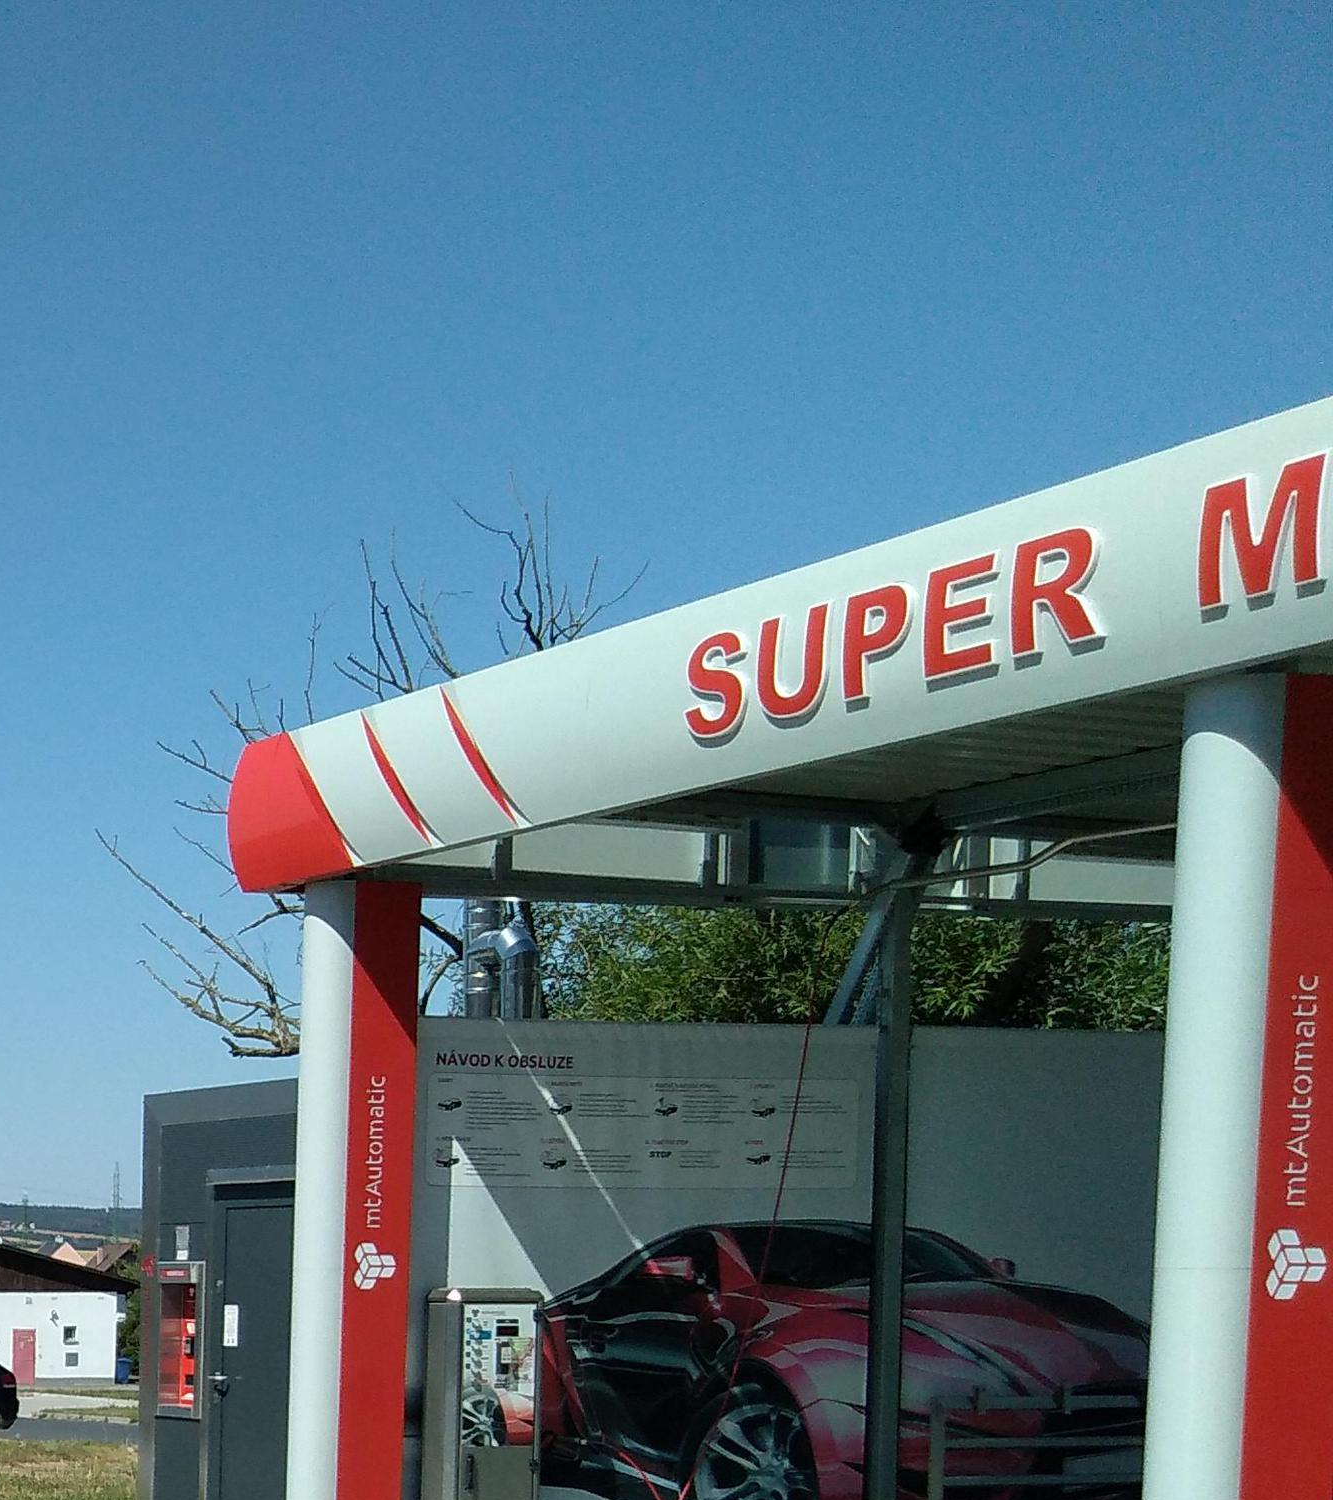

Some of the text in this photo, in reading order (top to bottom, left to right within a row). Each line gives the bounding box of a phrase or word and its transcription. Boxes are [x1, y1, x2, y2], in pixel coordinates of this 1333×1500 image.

[683, 526, 1107, 748] SUPER
[363, 1075, 387, 1229] mtAutomatic
[436, 1050, 574, 1069] NÁVOD K OBSLUZE
[1285, 973, 1319, 1207] mtAutomatic
